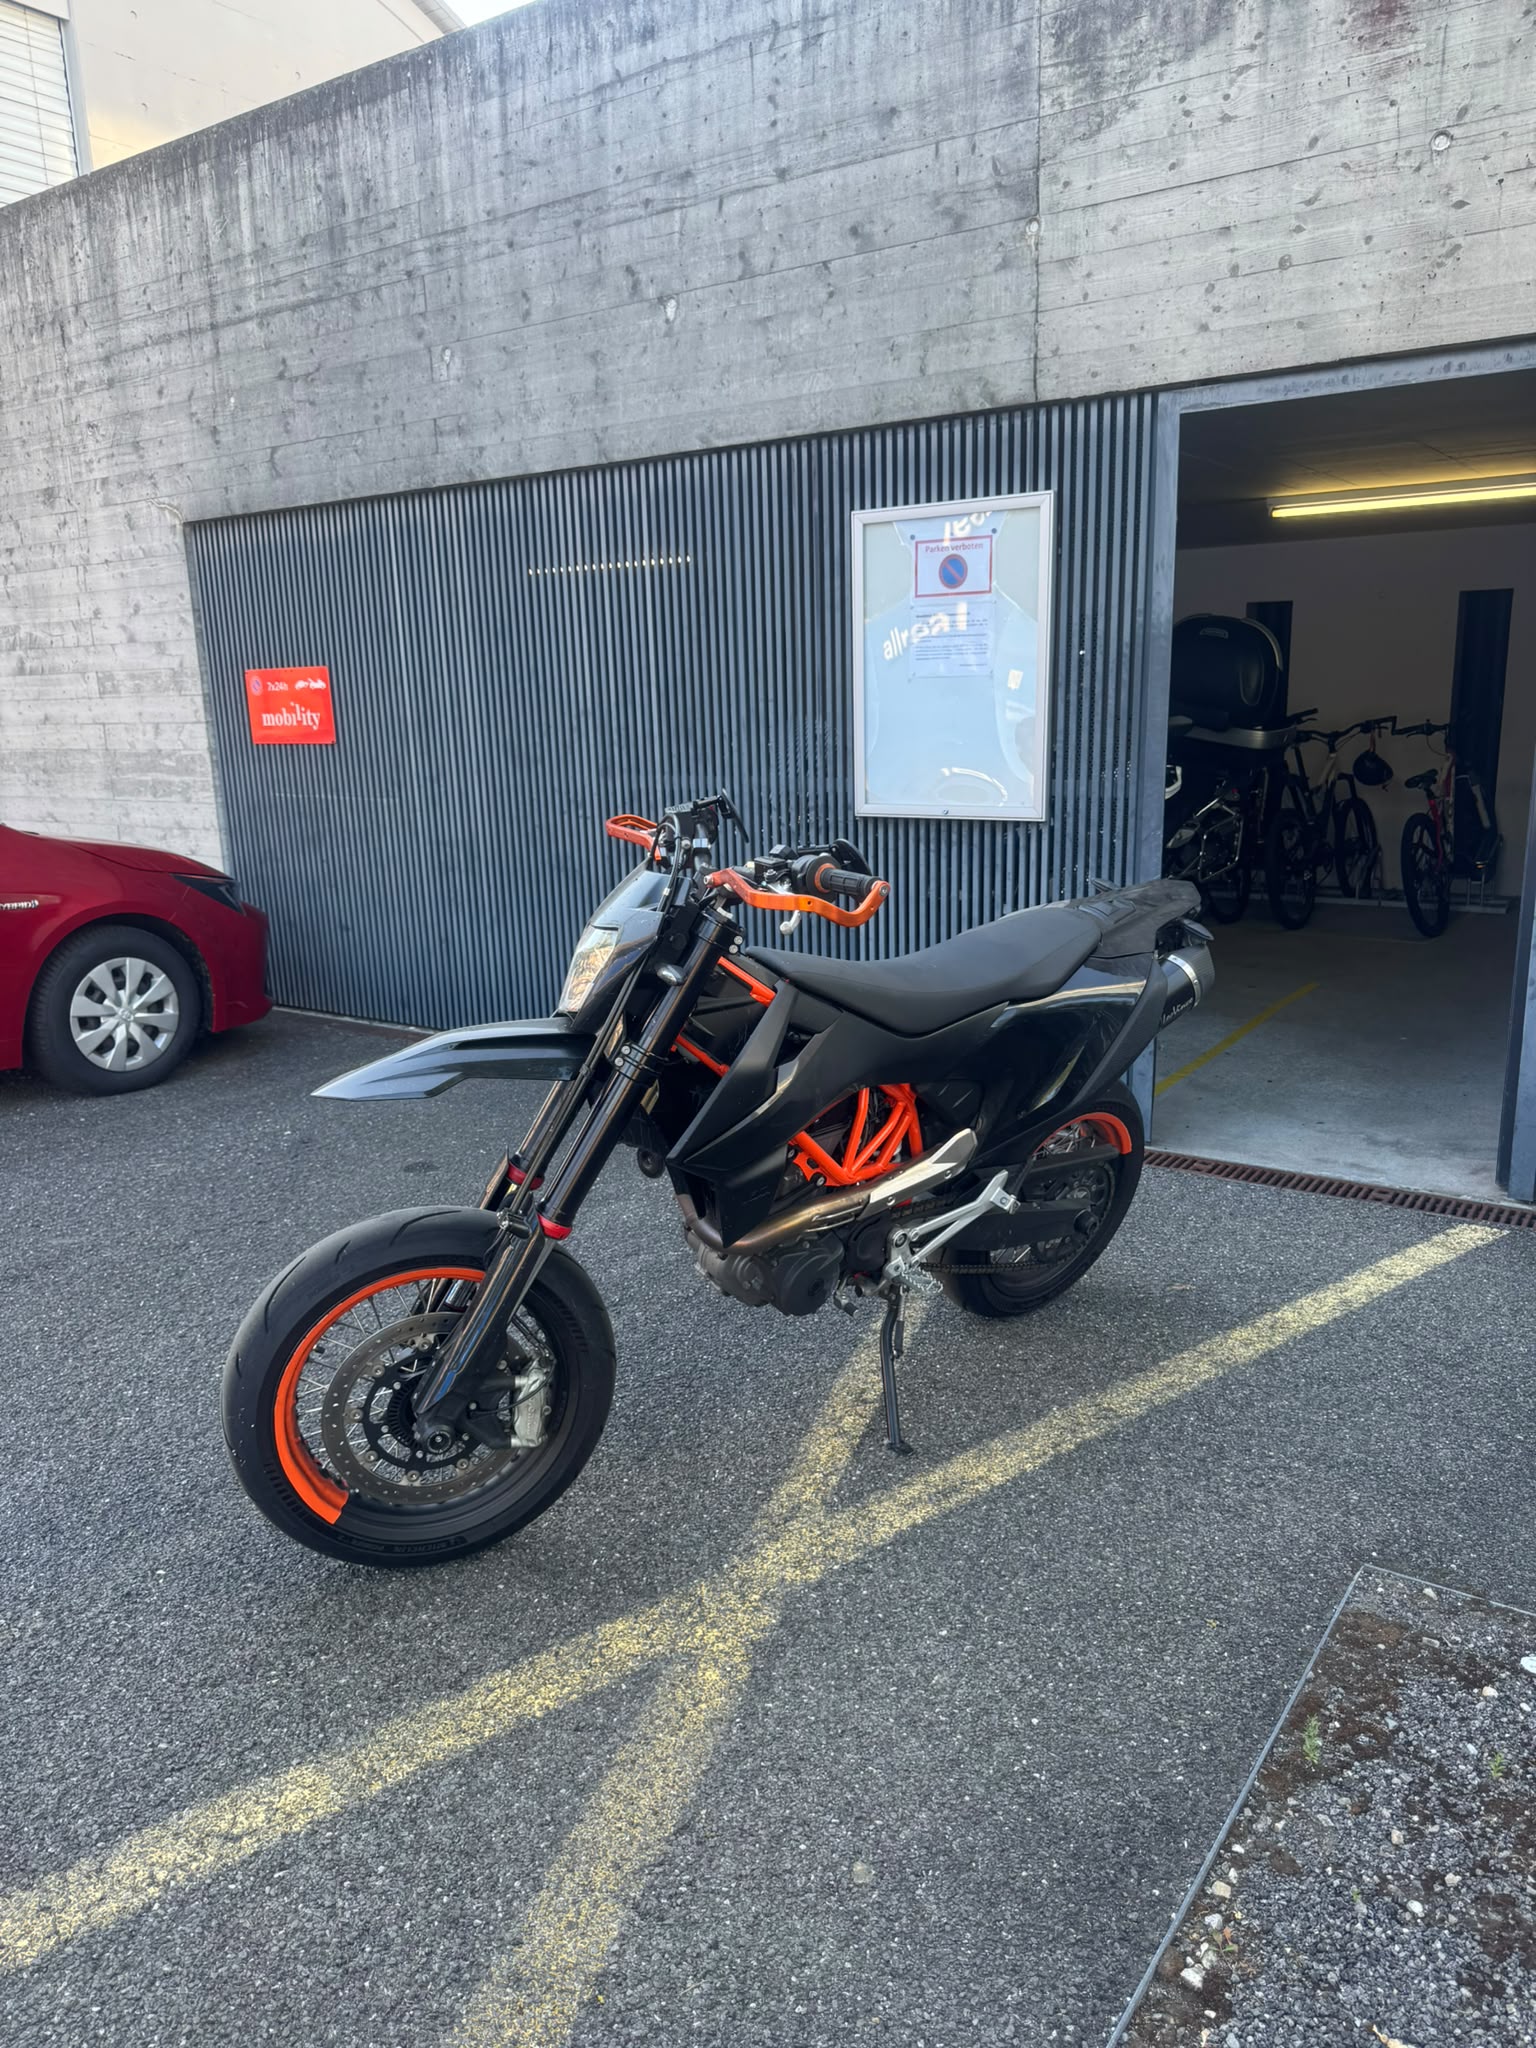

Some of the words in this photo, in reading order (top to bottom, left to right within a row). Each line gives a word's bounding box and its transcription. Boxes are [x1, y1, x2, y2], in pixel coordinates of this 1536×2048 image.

[925, 544, 949, 553] Parken
[950, 542, 983, 551] verboten
[883, 601, 968, 660] allreal
[261, 701, 320, 730] mobility
